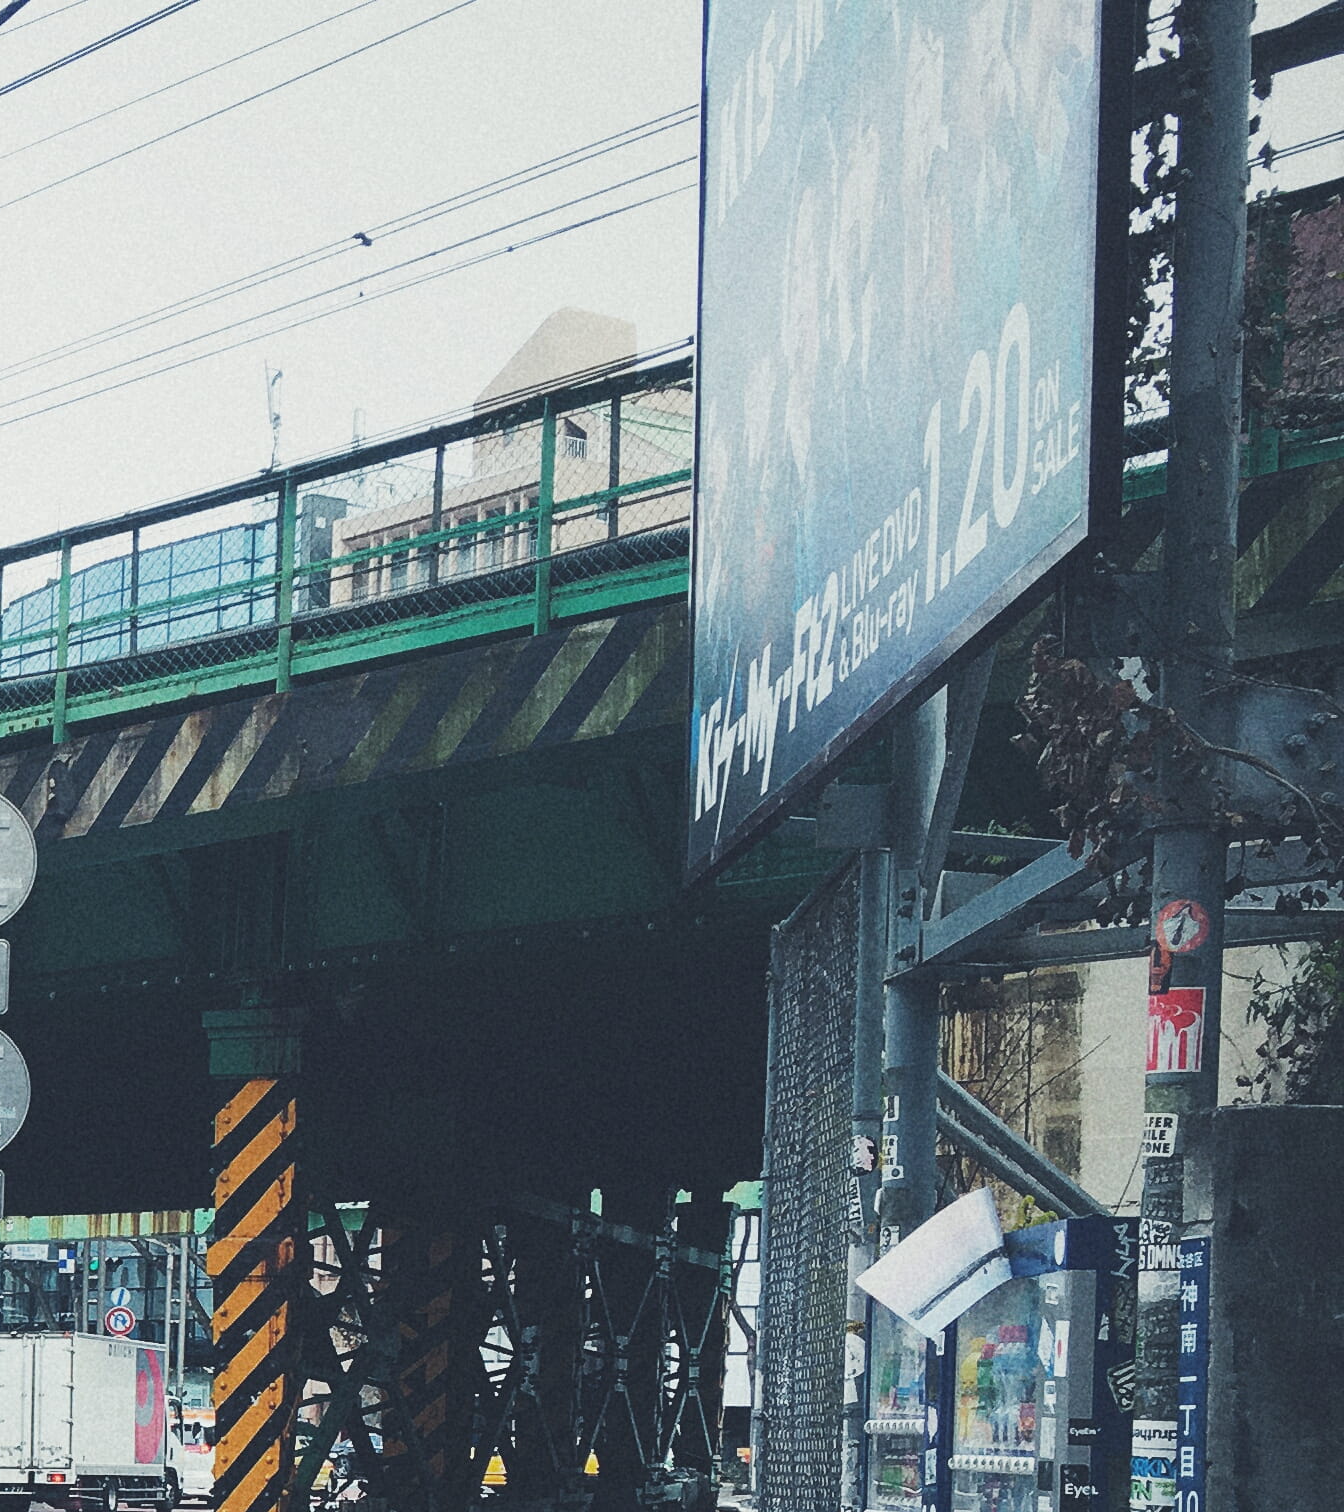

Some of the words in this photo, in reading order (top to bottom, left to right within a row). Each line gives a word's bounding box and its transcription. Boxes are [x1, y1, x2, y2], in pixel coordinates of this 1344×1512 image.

[1030, 401, 1080, 496] SALE
[1034, 359, 1060, 432] ON
[923, 302, 1030, 605] 1.20
[841, 528, 881, 620] LIVE
[882, 487, 921, 578] DVD
[839, 637, 849, 682] &
[851, 568, 919, 673] Blu-ray
[1133, 1429, 1177, 1442] druthe
[1179, 1280, 1198, 1477] 神南一丁目
